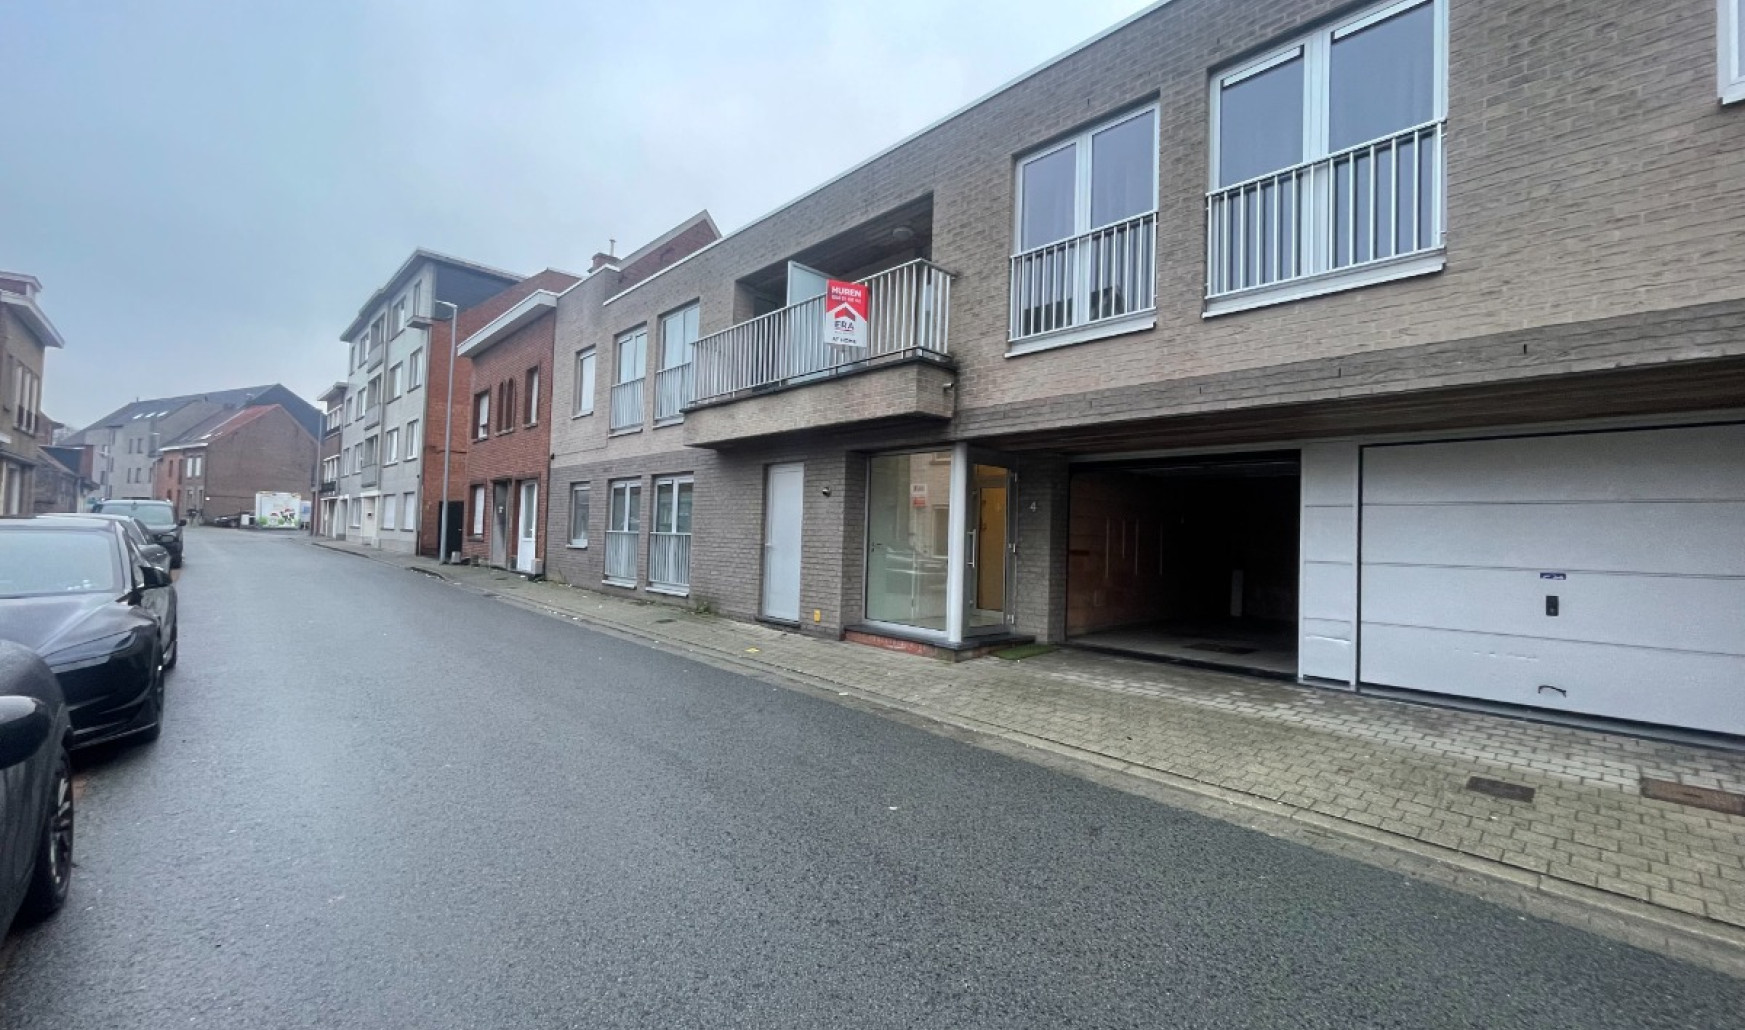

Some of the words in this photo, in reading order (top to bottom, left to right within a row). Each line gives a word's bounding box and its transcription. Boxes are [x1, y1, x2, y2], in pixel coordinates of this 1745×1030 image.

[831, 286, 861, 298] HUREN
[834, 320, 855, 331] ERA
[1029, 501, 1037, 512] 4
